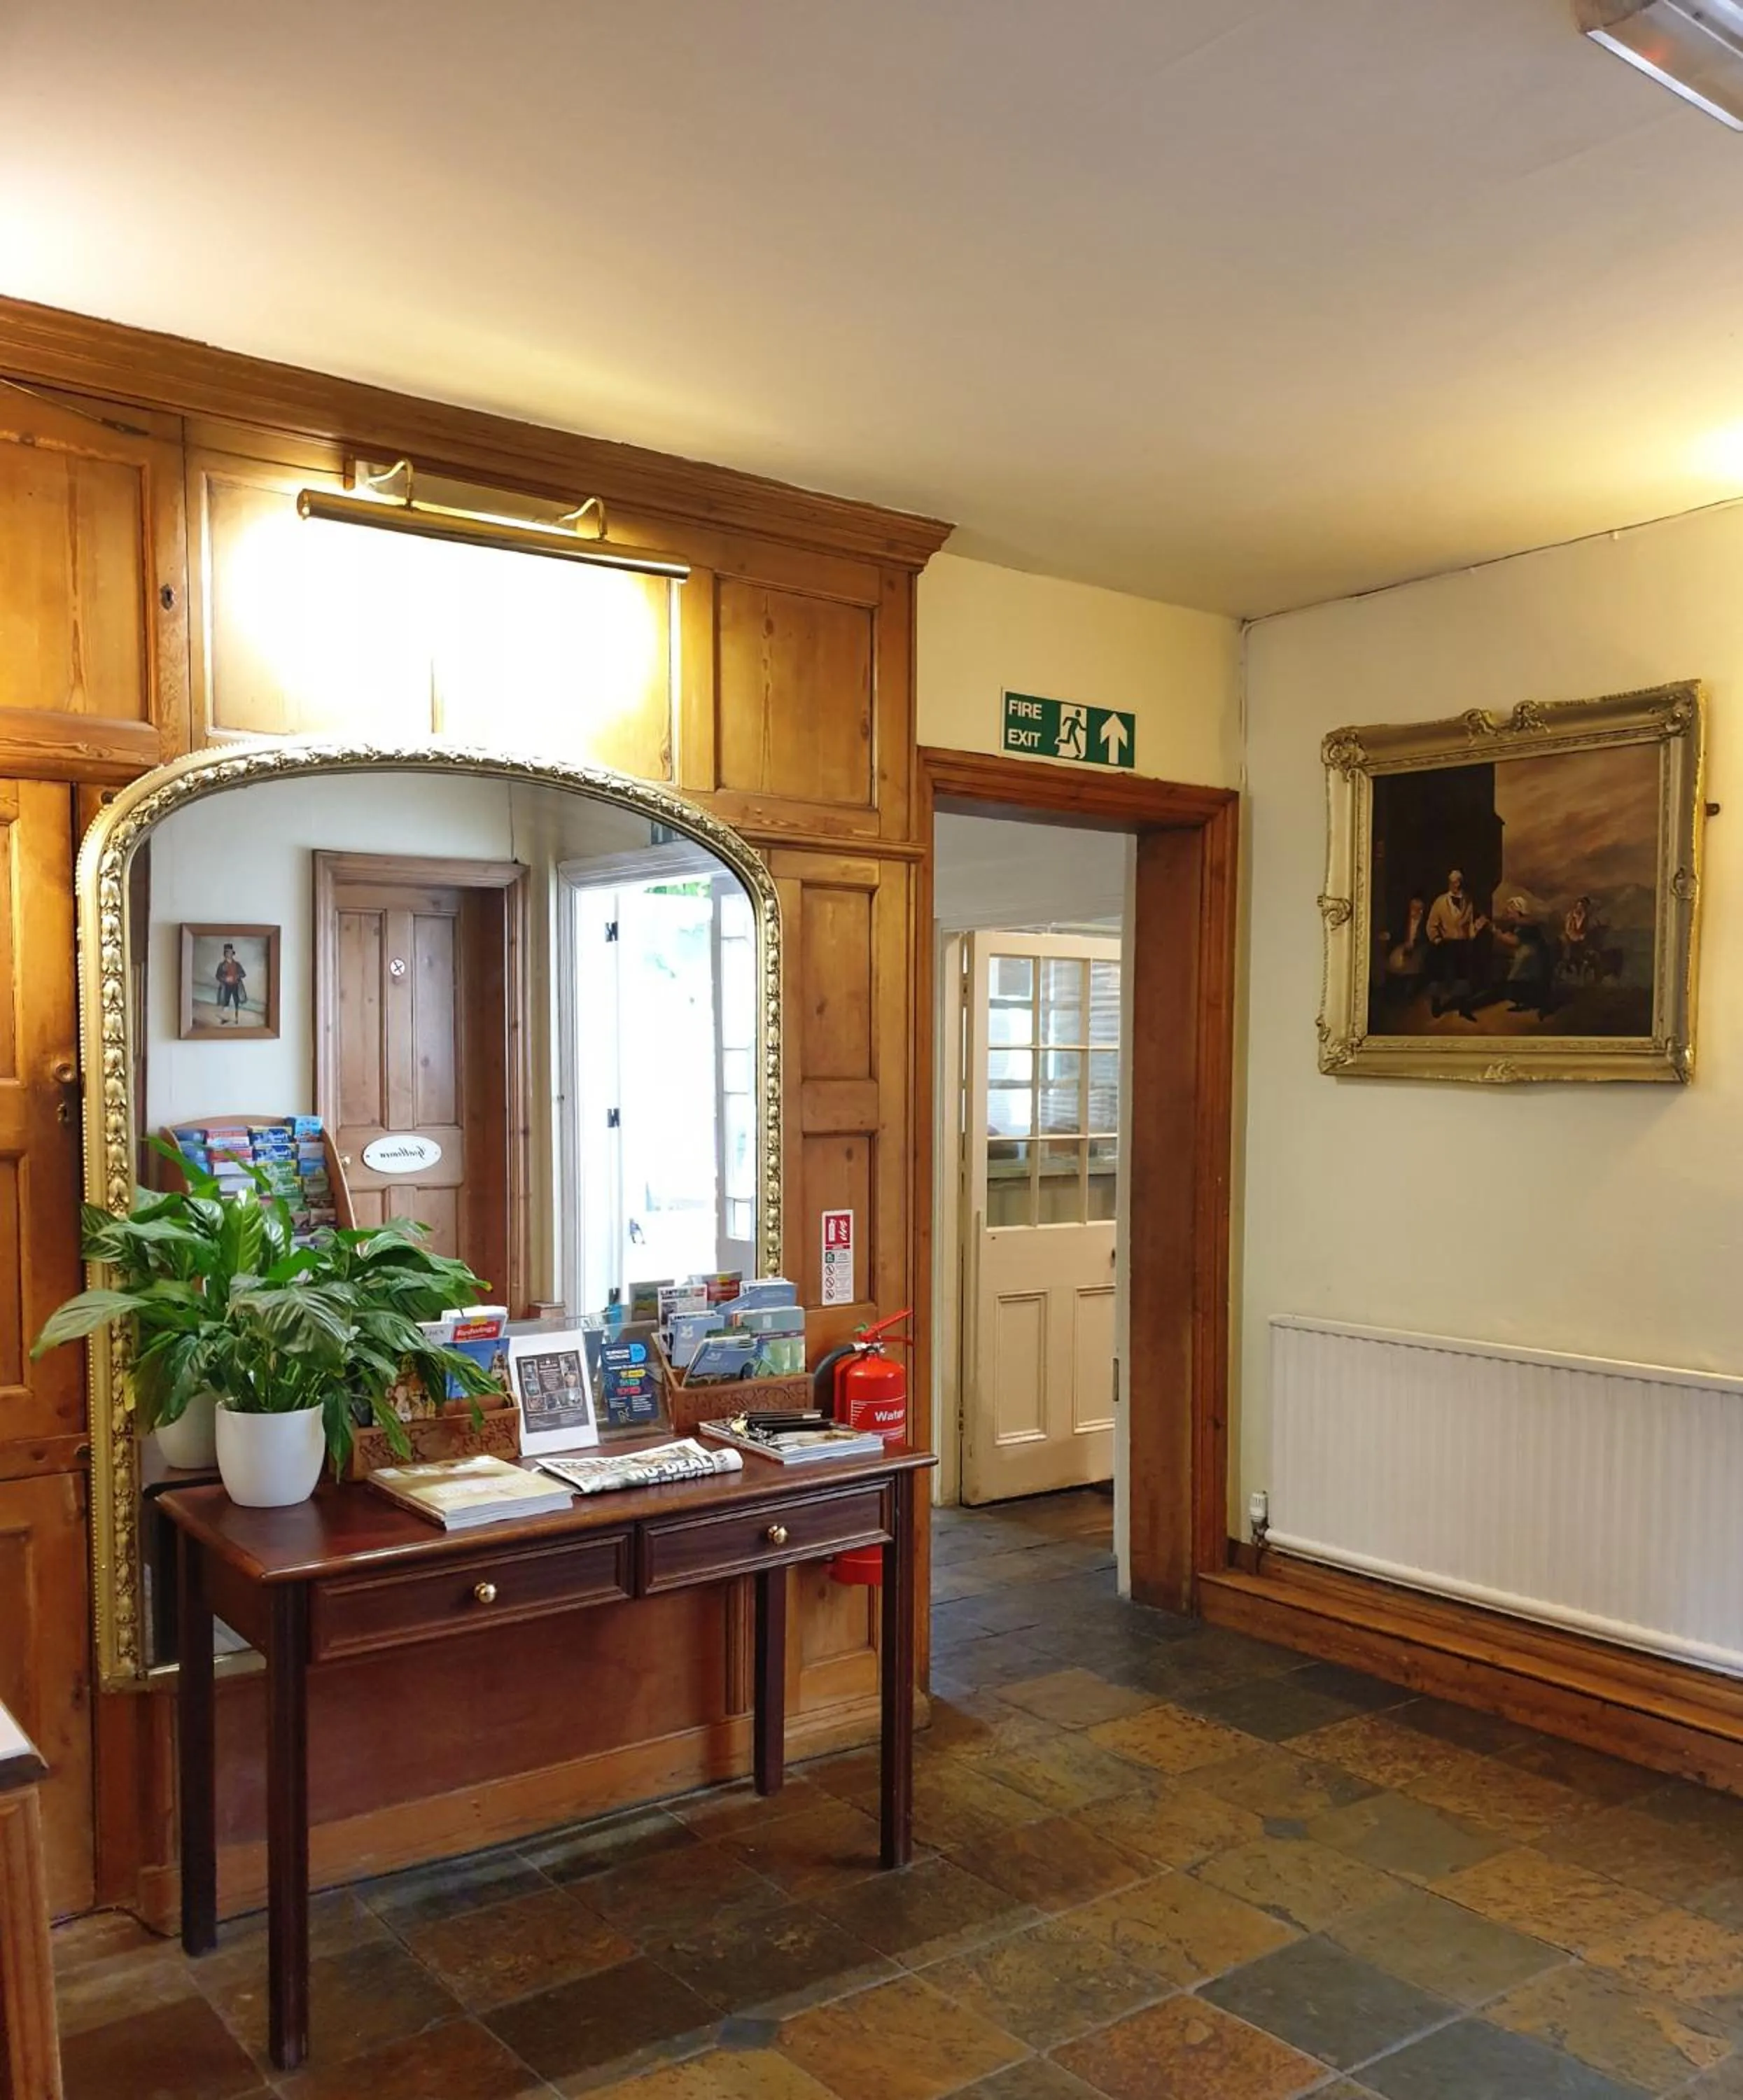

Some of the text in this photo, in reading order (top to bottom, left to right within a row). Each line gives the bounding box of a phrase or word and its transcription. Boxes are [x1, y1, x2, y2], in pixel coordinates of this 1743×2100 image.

[1008, 700, 1042, 720] FIRE
[1007, 729, 1041, 748] EXIT
[874, 1409, 905, 1422] Water
[627, 1455, 713, 1480] NO-DEAL
